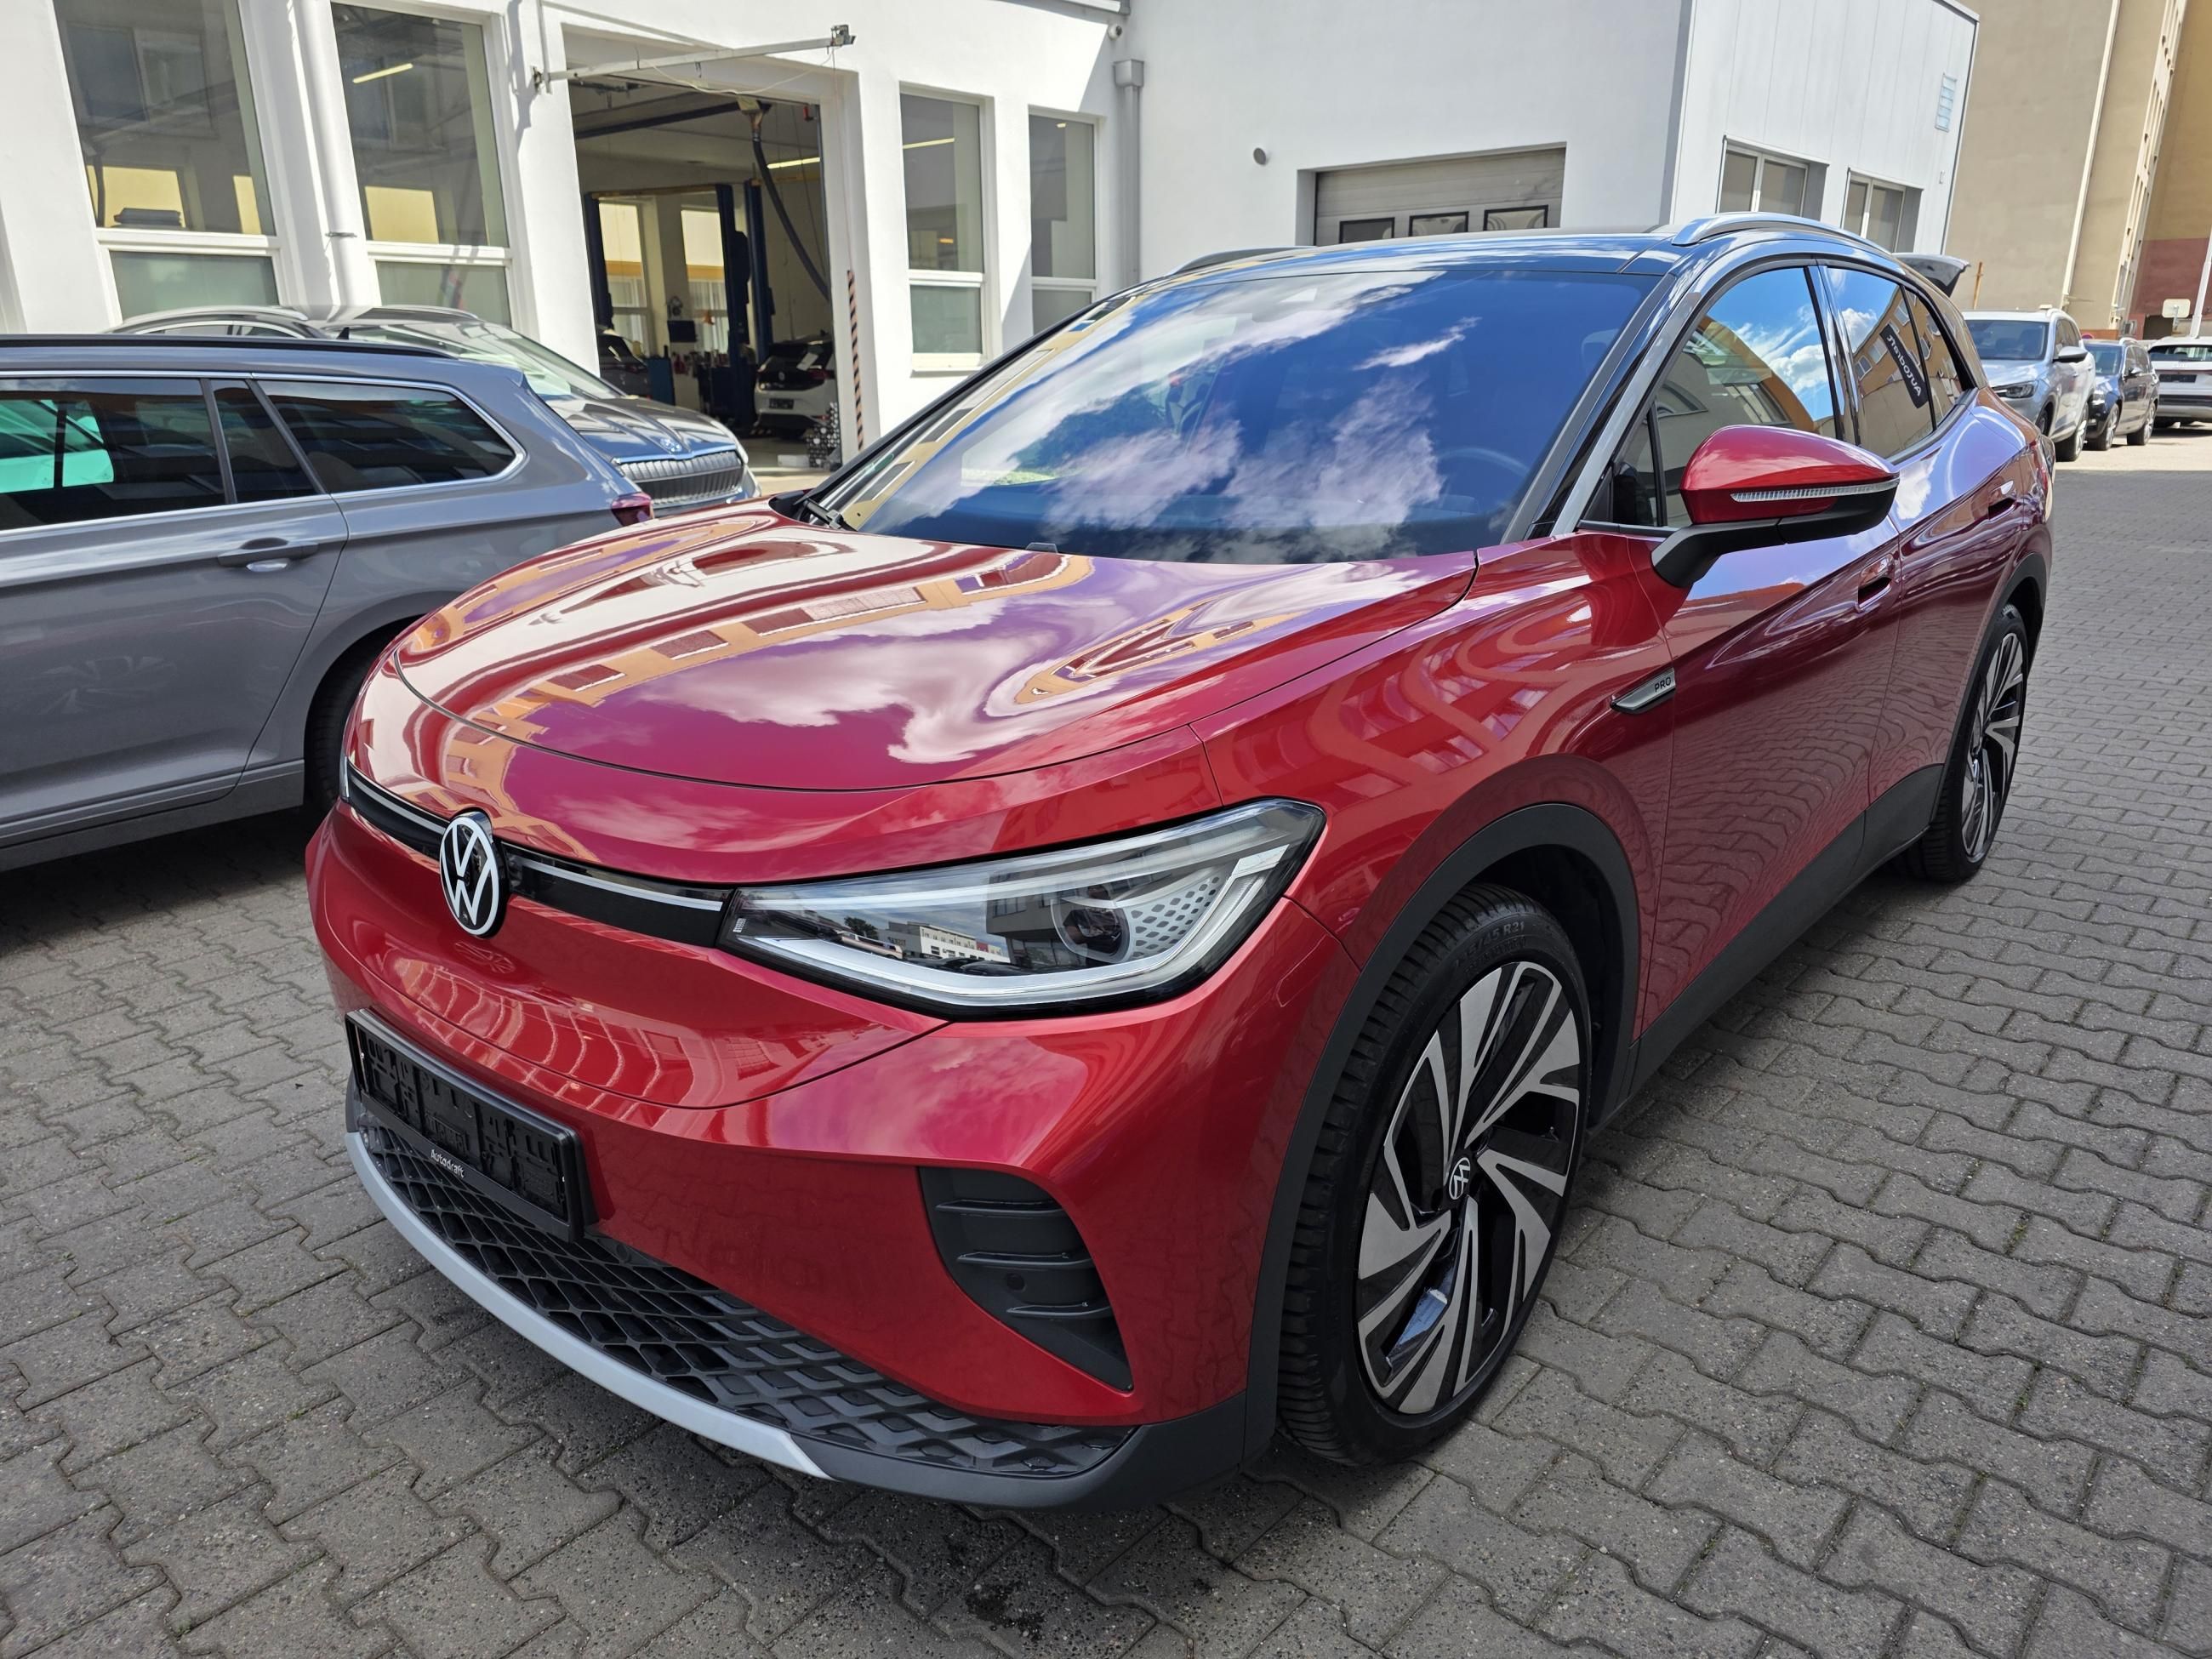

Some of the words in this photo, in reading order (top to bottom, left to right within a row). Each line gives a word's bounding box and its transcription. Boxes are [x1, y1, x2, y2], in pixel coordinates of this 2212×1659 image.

[1655, 677, 1671, 692] PRO
[1503, 921, 1525, 938] R21
[430, 1149, 465, 1179] Autodraft
